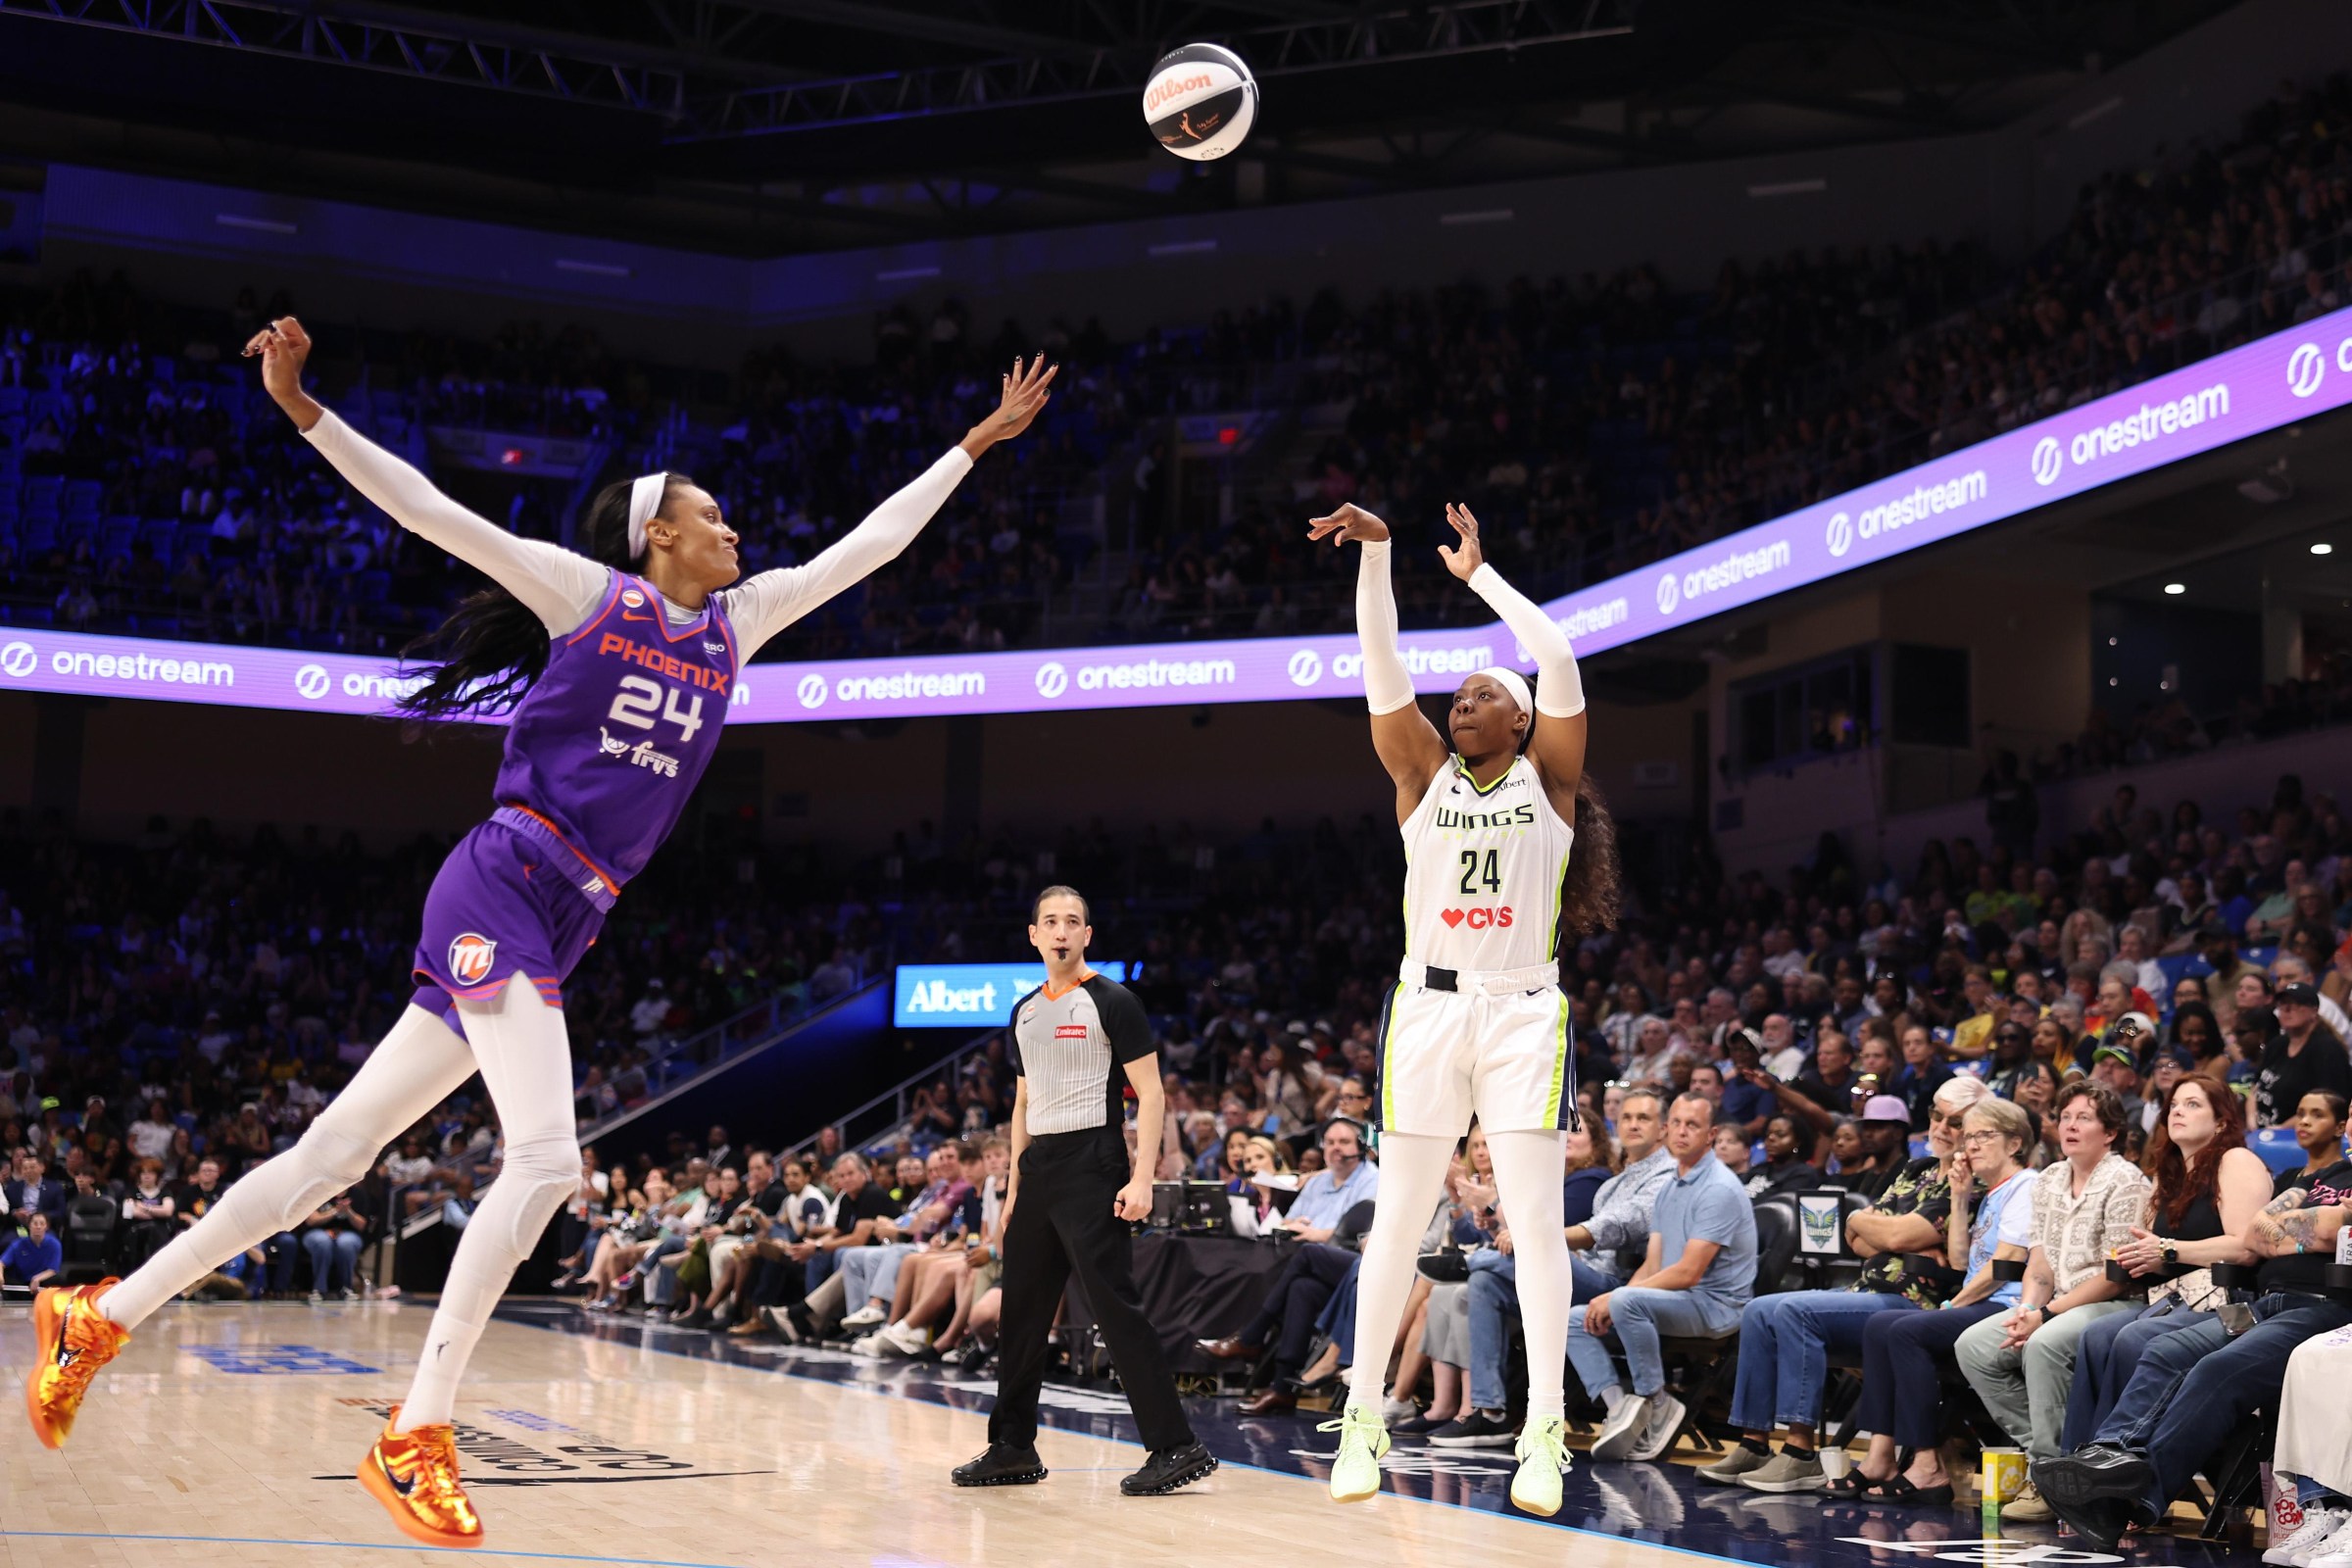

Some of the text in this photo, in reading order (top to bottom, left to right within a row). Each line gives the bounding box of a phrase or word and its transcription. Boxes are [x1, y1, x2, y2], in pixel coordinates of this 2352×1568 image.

[1146, 74, 1213, 111] Wilson
[2070, 383, 2230, 466] onestream
[1858, 469, 1986, 540] onestream
[1683, 539, 1790, 600] onestream
[51, 651, 234, 687] onestream
[598, 632, 729, 697] PHOENIX
[1076, 658, 1237, 691] onestream
[836, 670, 986, 702] onestream
[608, 673, 704, 743] 24
[630, 740, 680, 778] fry's
[1436, 803, 1536, 830] WINGS
[1460, 849, 1500, 895] 24
[1466, 906, 1513, 930] CVS
[906, 979, 997, 1013] Albert
[1055, 1026, 1087, 1037] Emirates
[2274, 1498, 2295, 1514] POP
[2278, 1509, 2304, 1525] CORN
